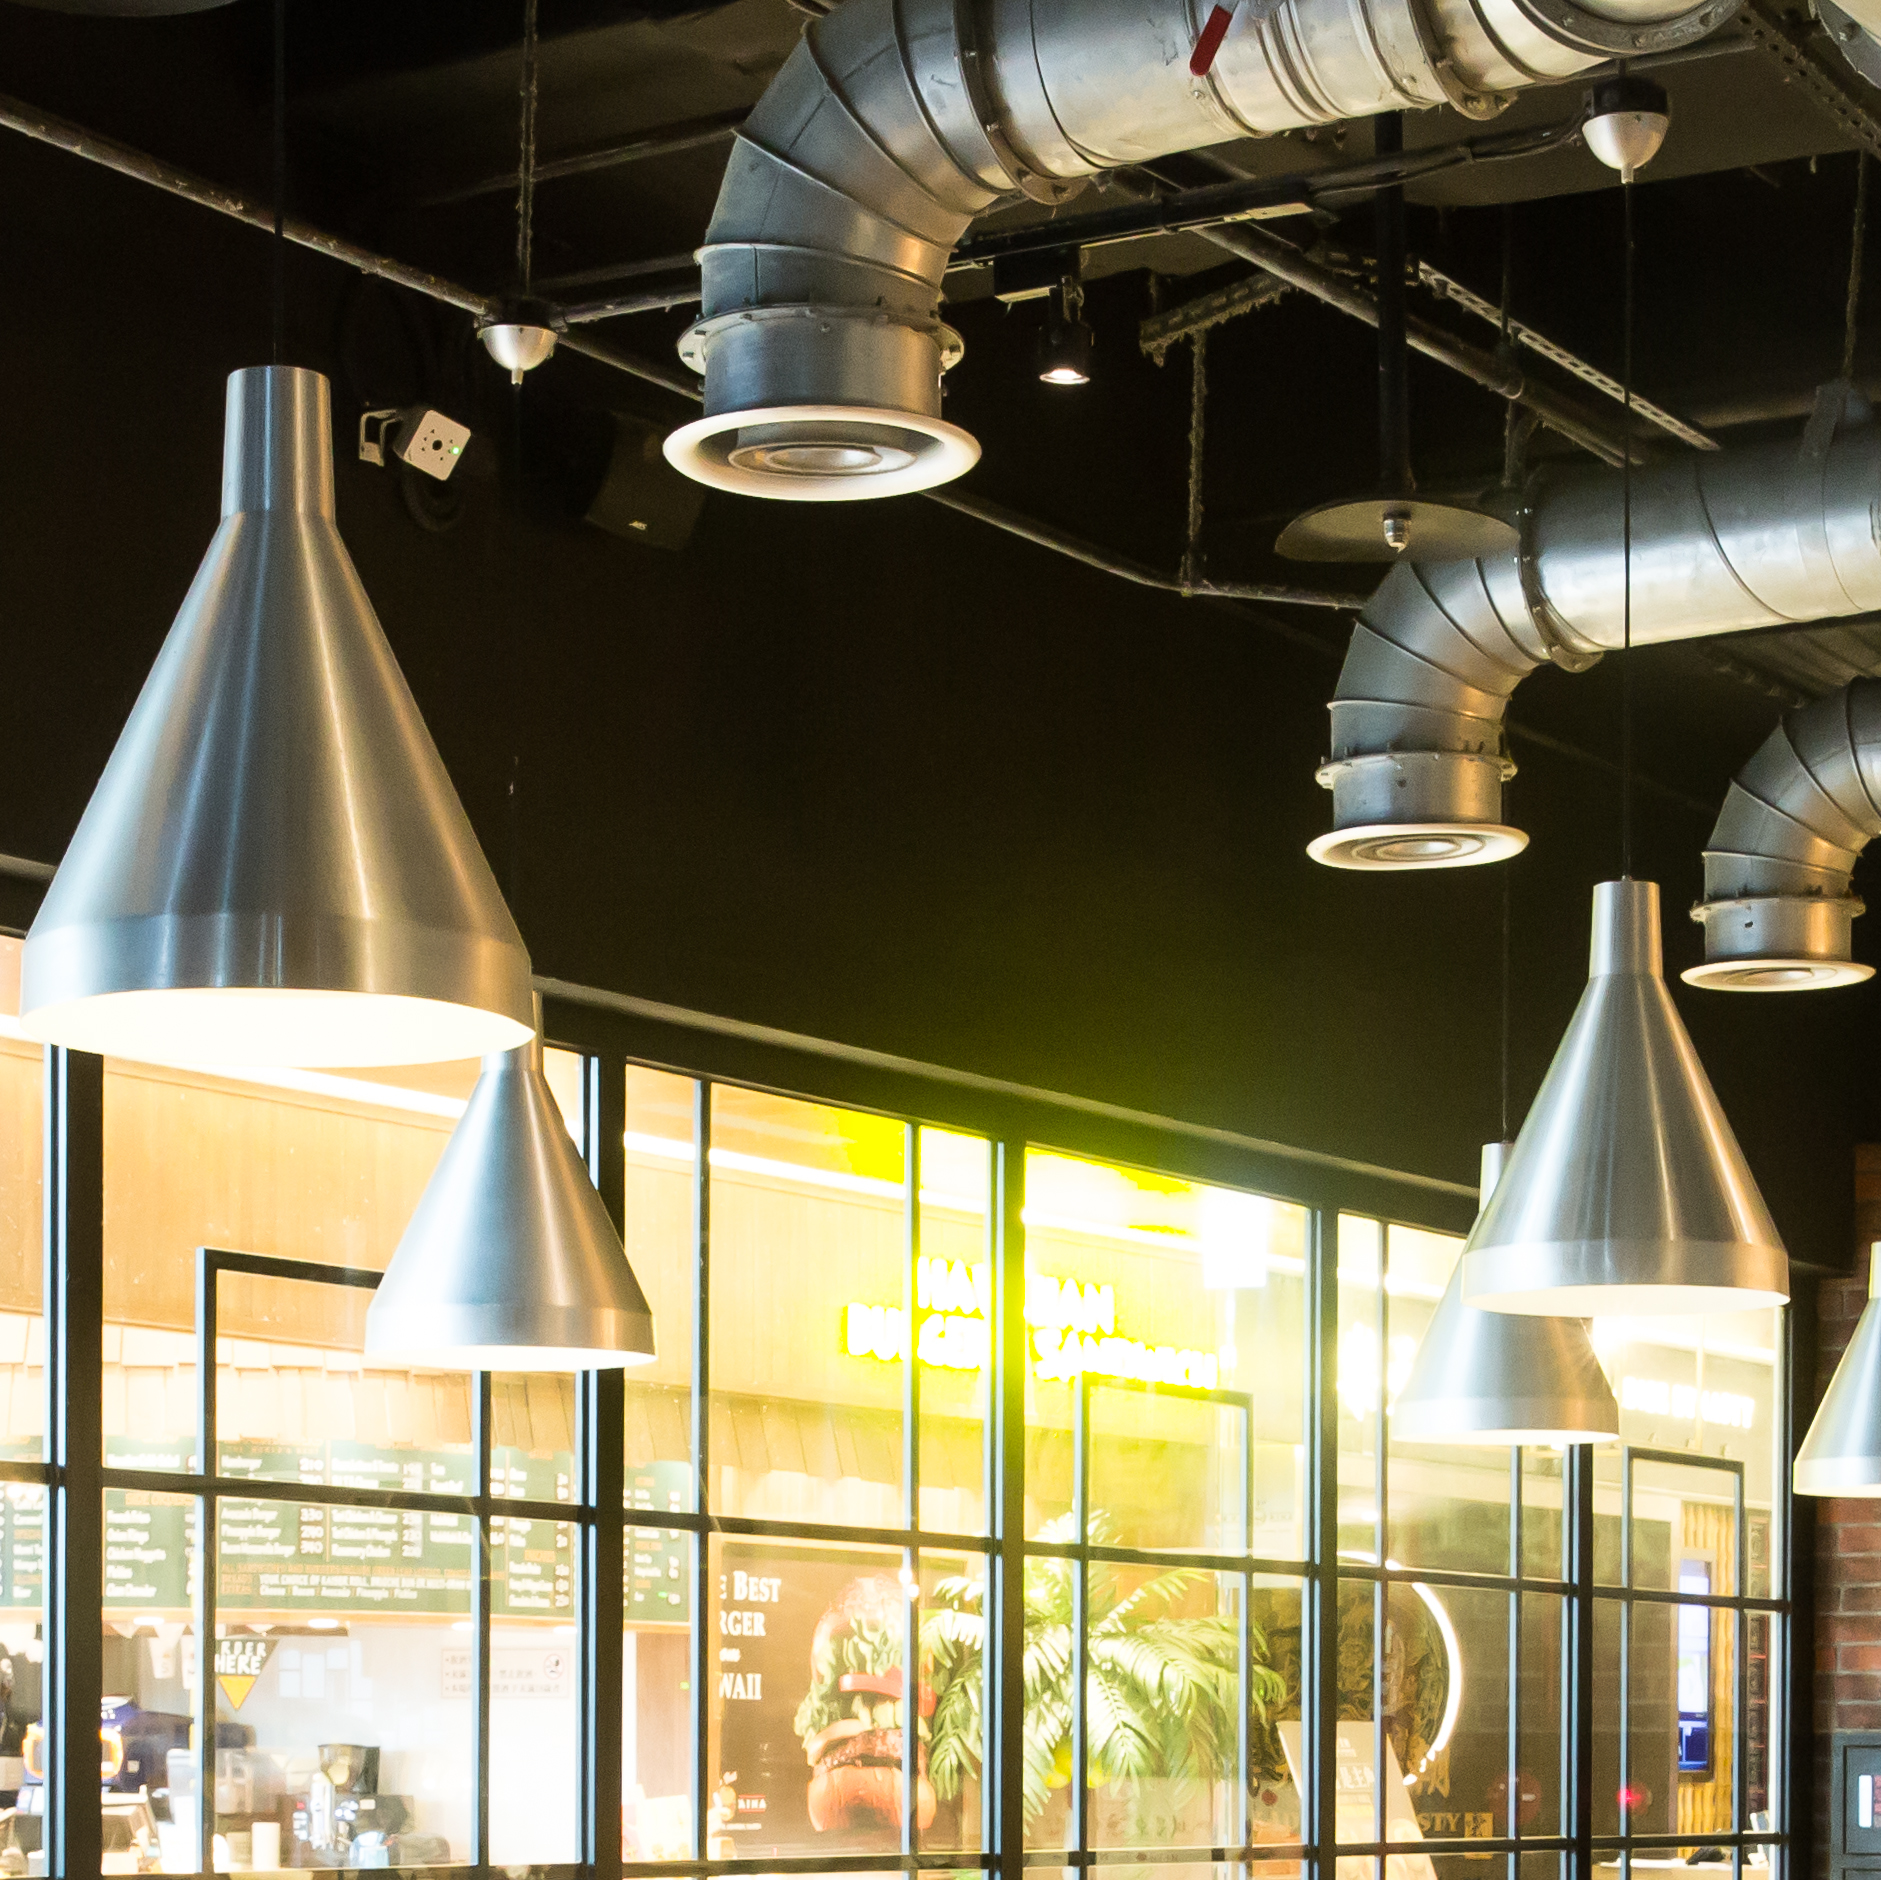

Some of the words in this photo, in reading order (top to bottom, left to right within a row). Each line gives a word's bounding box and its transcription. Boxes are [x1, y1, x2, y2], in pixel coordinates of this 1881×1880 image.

[1034, 1327, 1219, 1391] SANDWICH
[732, 1570, 783, 1603] BEST
[719, 1610, 767, 1638] RGER
[218, 1640, 267, 1657] RDER
[214, 1654, 262, 1675] HERE
[719, 1672, 763, 1702] WAII
[1417, 1811, 1464, 1833] STY
